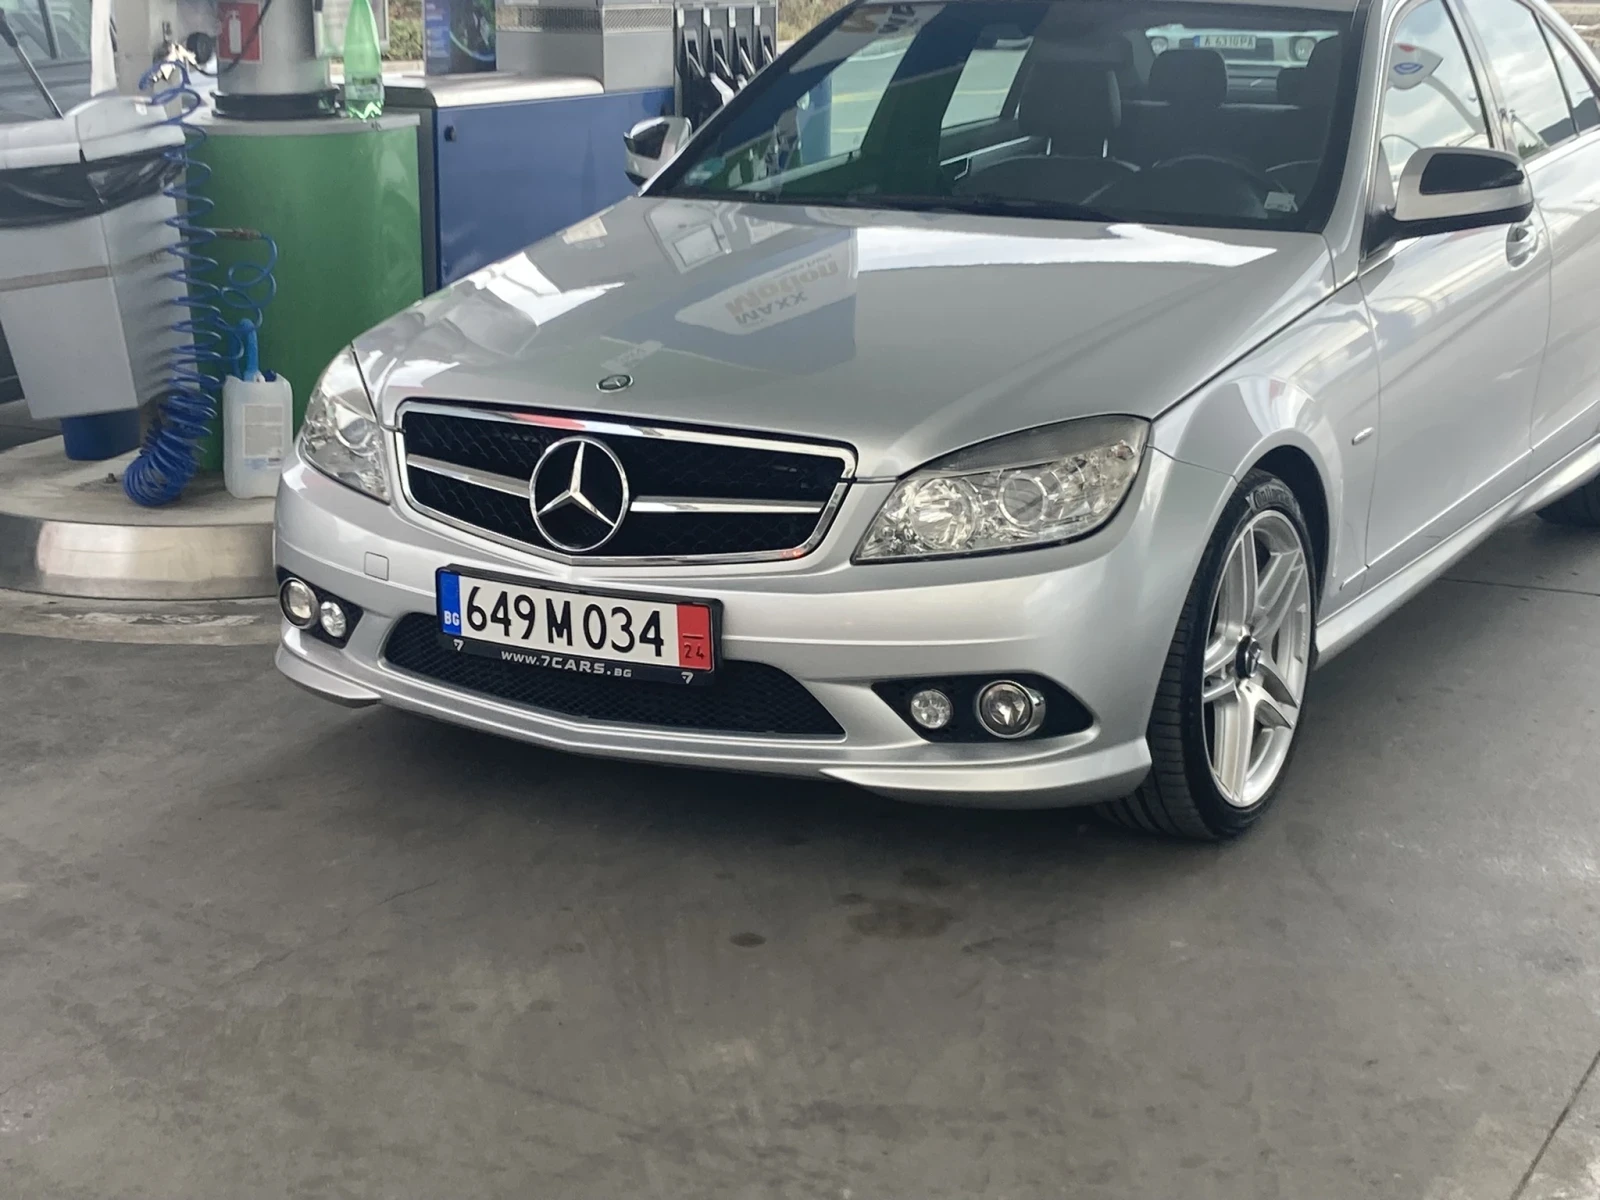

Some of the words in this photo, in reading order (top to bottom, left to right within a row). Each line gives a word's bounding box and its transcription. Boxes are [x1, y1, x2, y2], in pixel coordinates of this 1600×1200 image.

[444, 611, 460, 627] BG
[466, 586, 536, 640] 649
[545, 598, 573, 646] M
[583, 603, 664, 657] 034
[683, 643, 705, 660] 24
